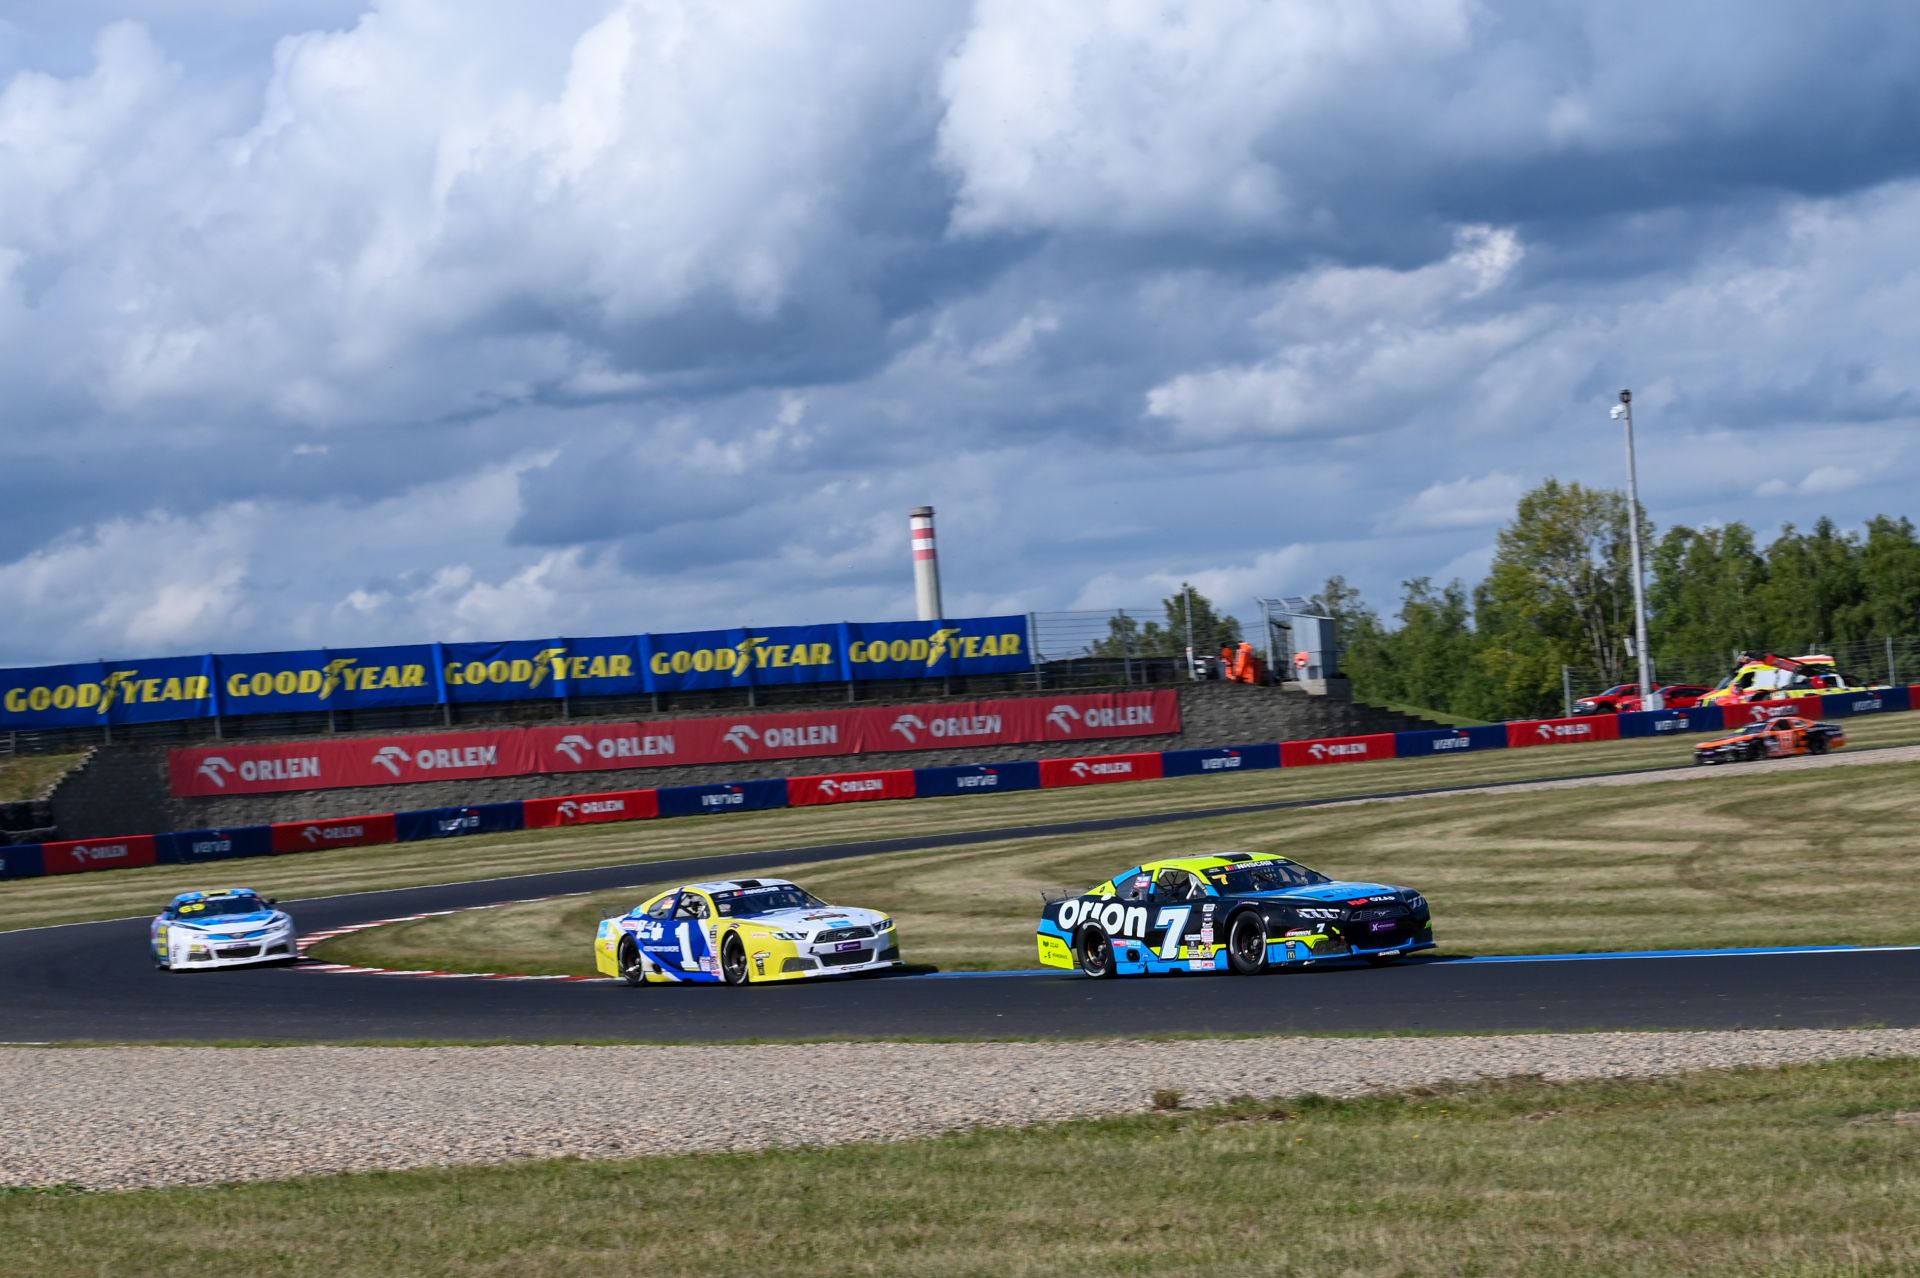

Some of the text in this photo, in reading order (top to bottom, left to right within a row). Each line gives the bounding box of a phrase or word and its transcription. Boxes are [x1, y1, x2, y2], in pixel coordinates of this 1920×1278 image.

[651, 641, 832, 675] GOODYEAR
[850, 632, 1021, 664] GOODYEAR
[227, 662, 427, 698] GOODYEAR
[444, 653, 634, 686] GOODYEAR
[4, 673, 210, 713] GOODYEAR
[930, 714, 1002, 738] ORLEN
[1085, 704, 1154, 728] ORLEN
[597, 735, 675, 759] ORLEN
[764, 724, 838, 748] ORLEN
[416, 745, 497, 770] ORLEN
[1328, 743, 1367, 756] ORLEN
[240, 757, 320, 781] ORLEN
[1091, 762, 1132, 775] ORLEN
[1201, 756, 1241, 769] verva
[839, 779, 883, 792] ORLEN
[956, 775, 998, 787] verva
[581, 800, 624, 813] ORLEN
[702, 793, 744, 806] verva
[323, 825, 363, 839] ORLEN
[90, 844, 128, 859] ORLEN
[192, 839, 232, 854] verva
[1236, 860, 1274, 870] NASCAR
[1211, 874, 1228, 885] 7
[1058, 893, 1147, 938] orion
[1155, 905, 1192, 962] 7
[1316, 923, 1325, 933] 7
[674, 922, 699, 970] 1
